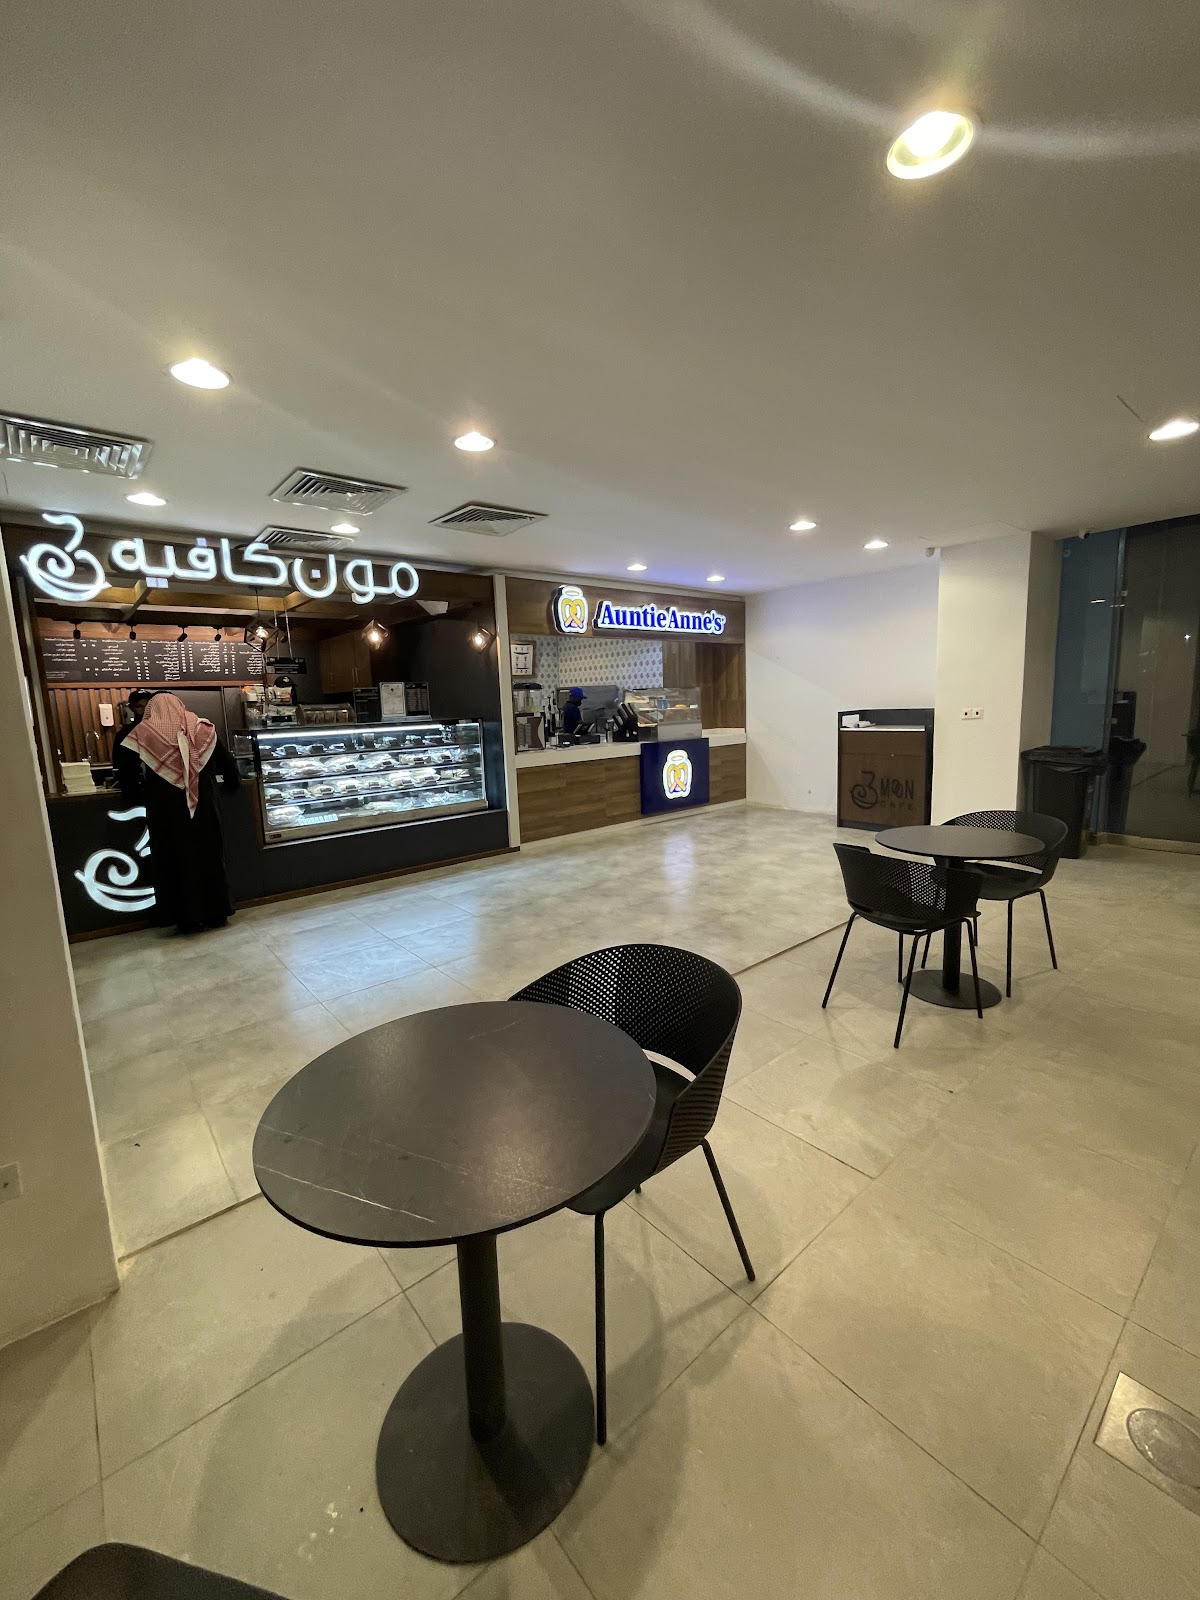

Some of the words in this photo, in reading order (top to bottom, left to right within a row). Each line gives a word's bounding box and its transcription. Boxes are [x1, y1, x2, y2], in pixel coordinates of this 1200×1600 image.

[110, 537, 289, 589] كافيه
[292, 554, 420, 605] مون
[600, 603, 667, 629] Auntie
[668, 609, 724, 632] Anne's
[880, 778, 914, 799] MOON
